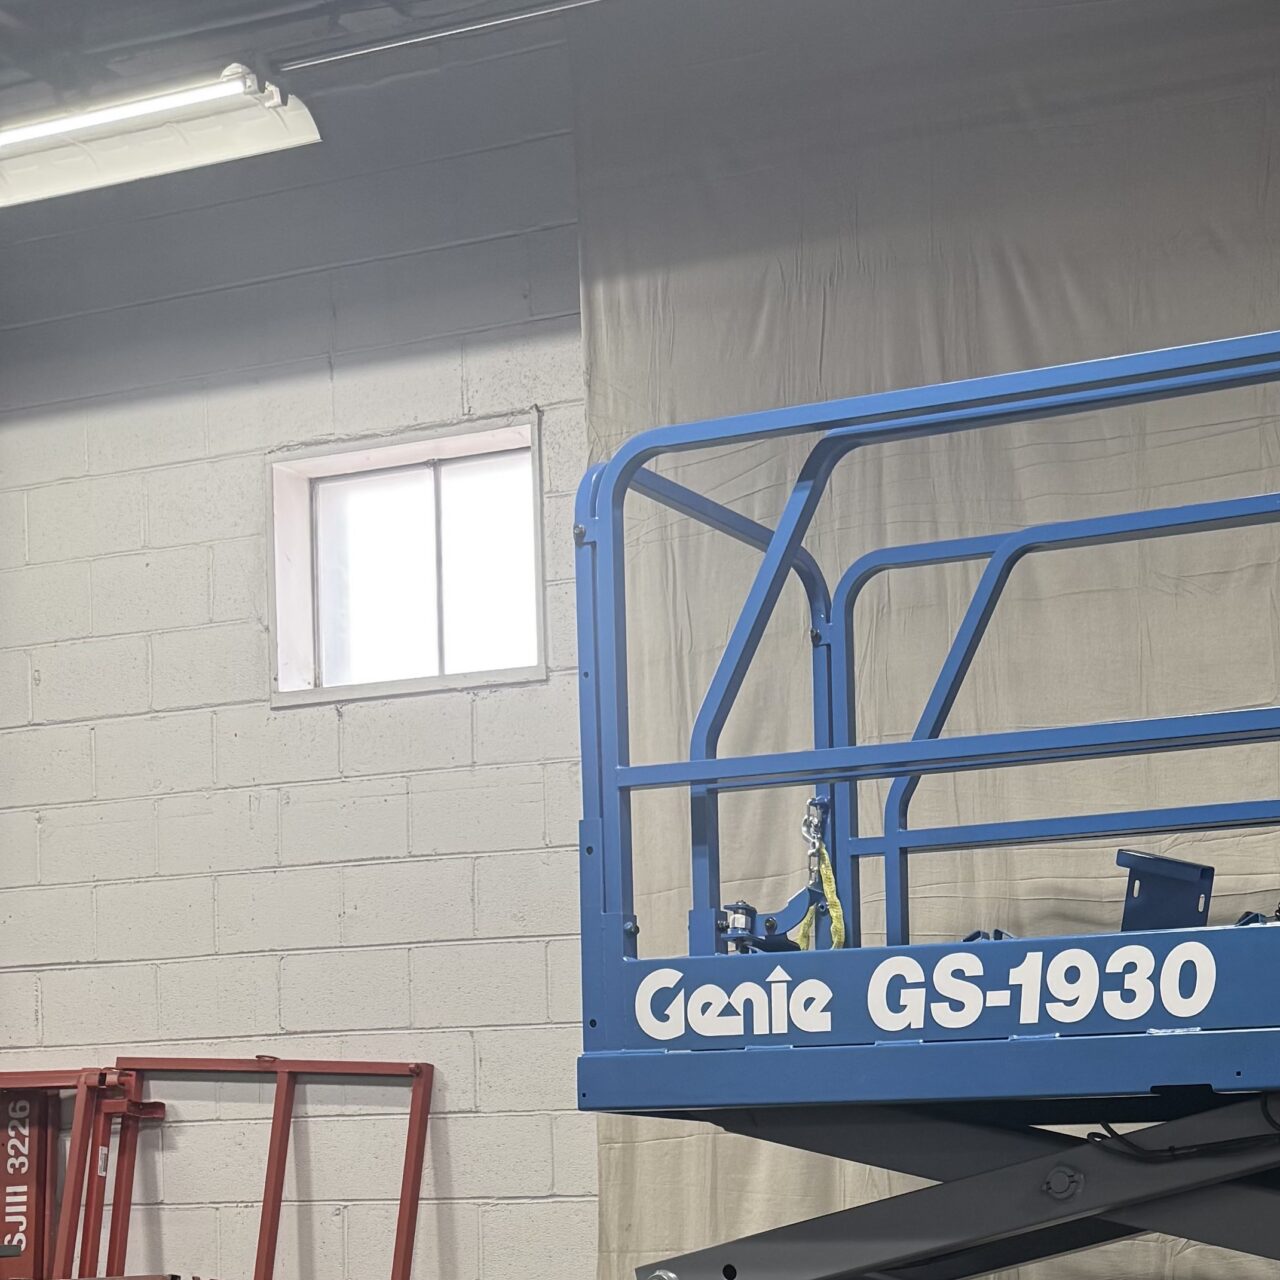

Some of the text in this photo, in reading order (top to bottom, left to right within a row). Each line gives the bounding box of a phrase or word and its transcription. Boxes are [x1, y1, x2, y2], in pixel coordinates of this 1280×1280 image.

[635, 941, 1217, 1040] Genie GS-1930
[7, 1100, 30, 1175] 3226
